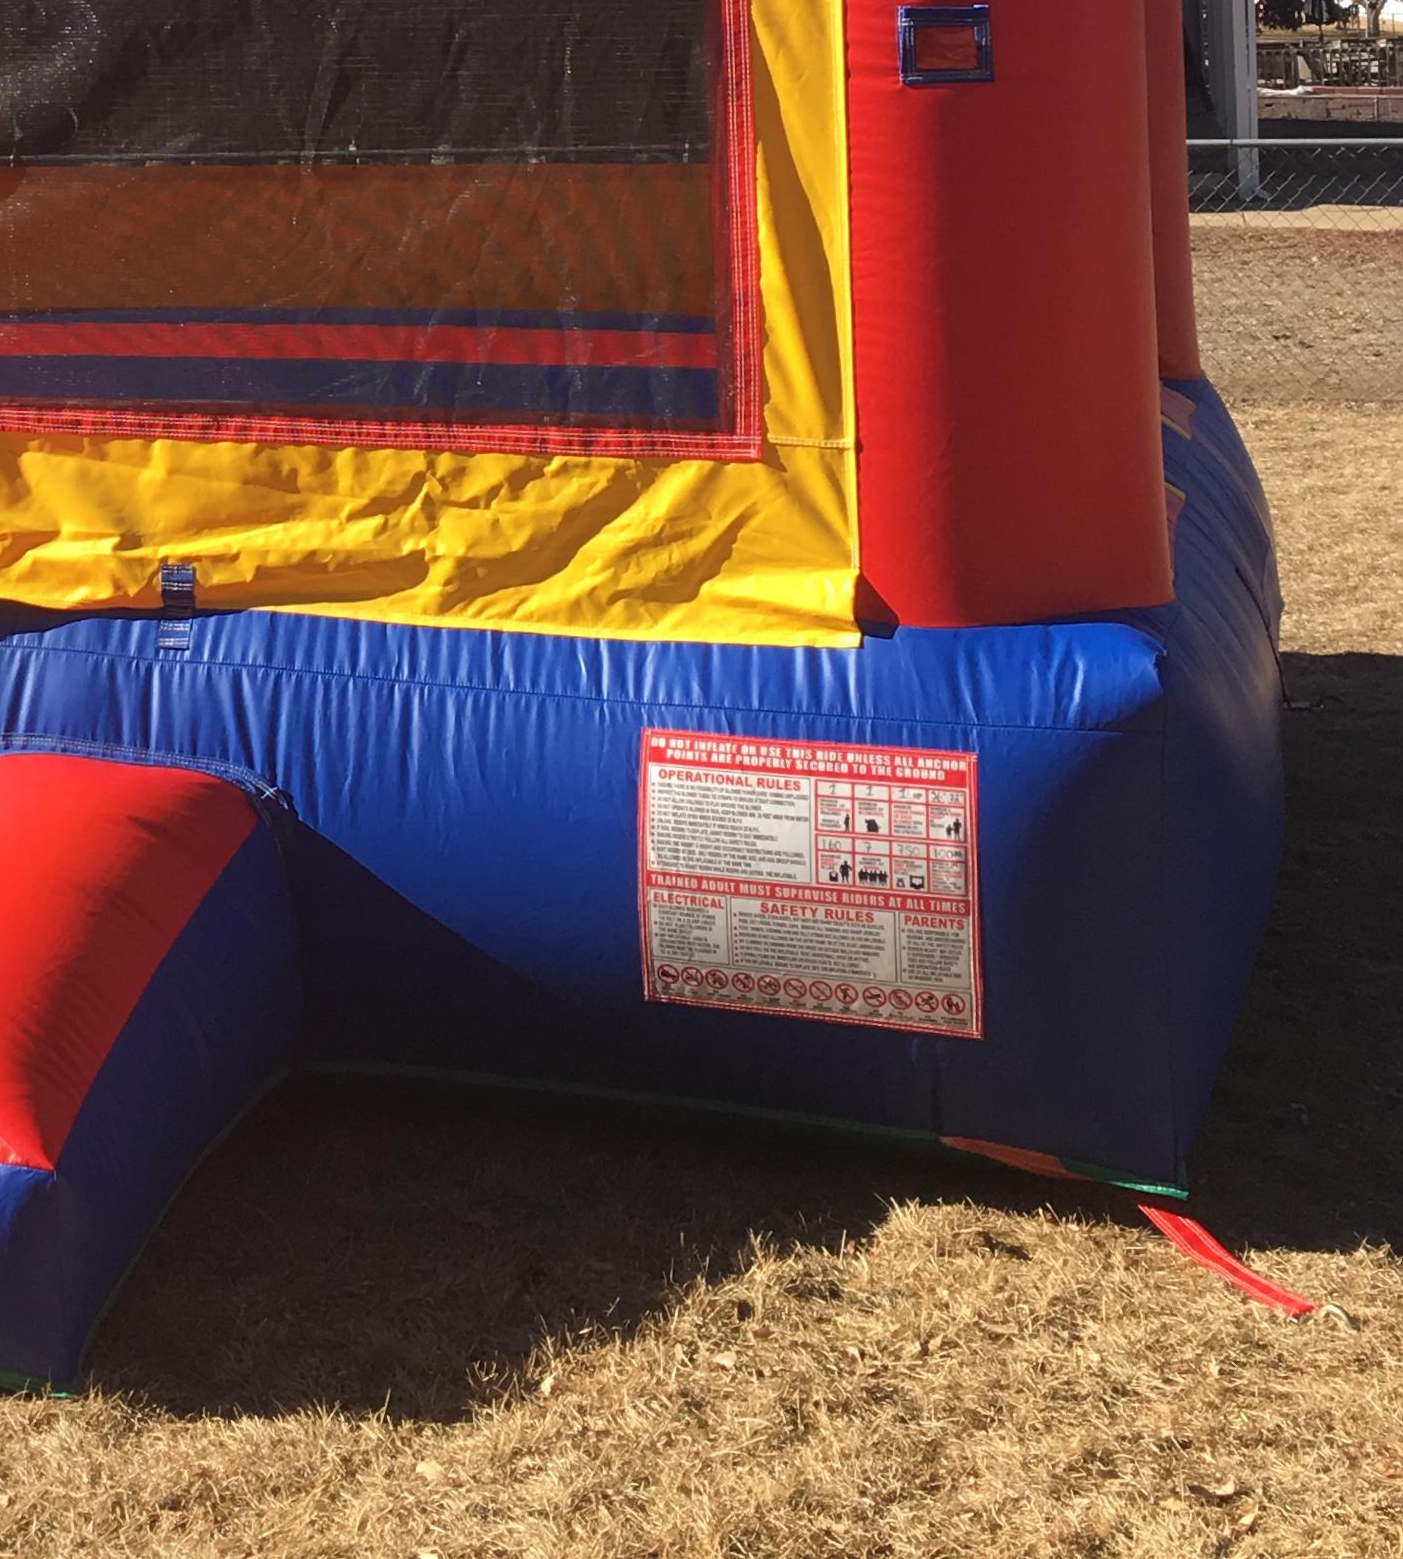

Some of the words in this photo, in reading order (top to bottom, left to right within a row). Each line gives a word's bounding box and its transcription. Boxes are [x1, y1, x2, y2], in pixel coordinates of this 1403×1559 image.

[651, 737, 665, 748] DO
[669, 738, 690, 750] NOT
[694, 740, 737, 754] INFLATE
[741, 744, 757, 755] OR
[761, 746, 781, 757] USE
[786, 748, 812, 760] THIS
[816, 750, 843, 762] RIDE
[847, 752, 891, 765] UNLESS
[894, 755, 914, 767] ALL
[918, 758, 967, 771] ANCHOR
[667, 748, 708, 762] POINTS
[711, 751, 732, 764] ARE
[736, 754, 792, 769] PROPERLY
[795, 759, 848, 773] SECURED
[852, 763, 867, 775] TO
[871, 765, 893, 777] THE
[895, 766, 945, 780] GROUND
[658, 768, 753, 788] OPERATIONAL
[756, 777, 801, 791] RULES
[651, 874, 698, 889] TRAINED
[701, 879, 736, 893] ADULT
[739, 883, 772, 897] MUST
[775, 887, 838, 903] SUPERVISE
[842, 892, 885, 906] RIDERS
[889, 896, 903, 908] AT
[906, 897, 925, 910] ALL
[929, 899, 966, 913] TIMES
[653, 892, 725, 909] ELECTRICAL
[760, 902, 818, 919] SAFETY
[824, 908, 875, 923] RULES
[904, 914, 964, 931] PARENTS
